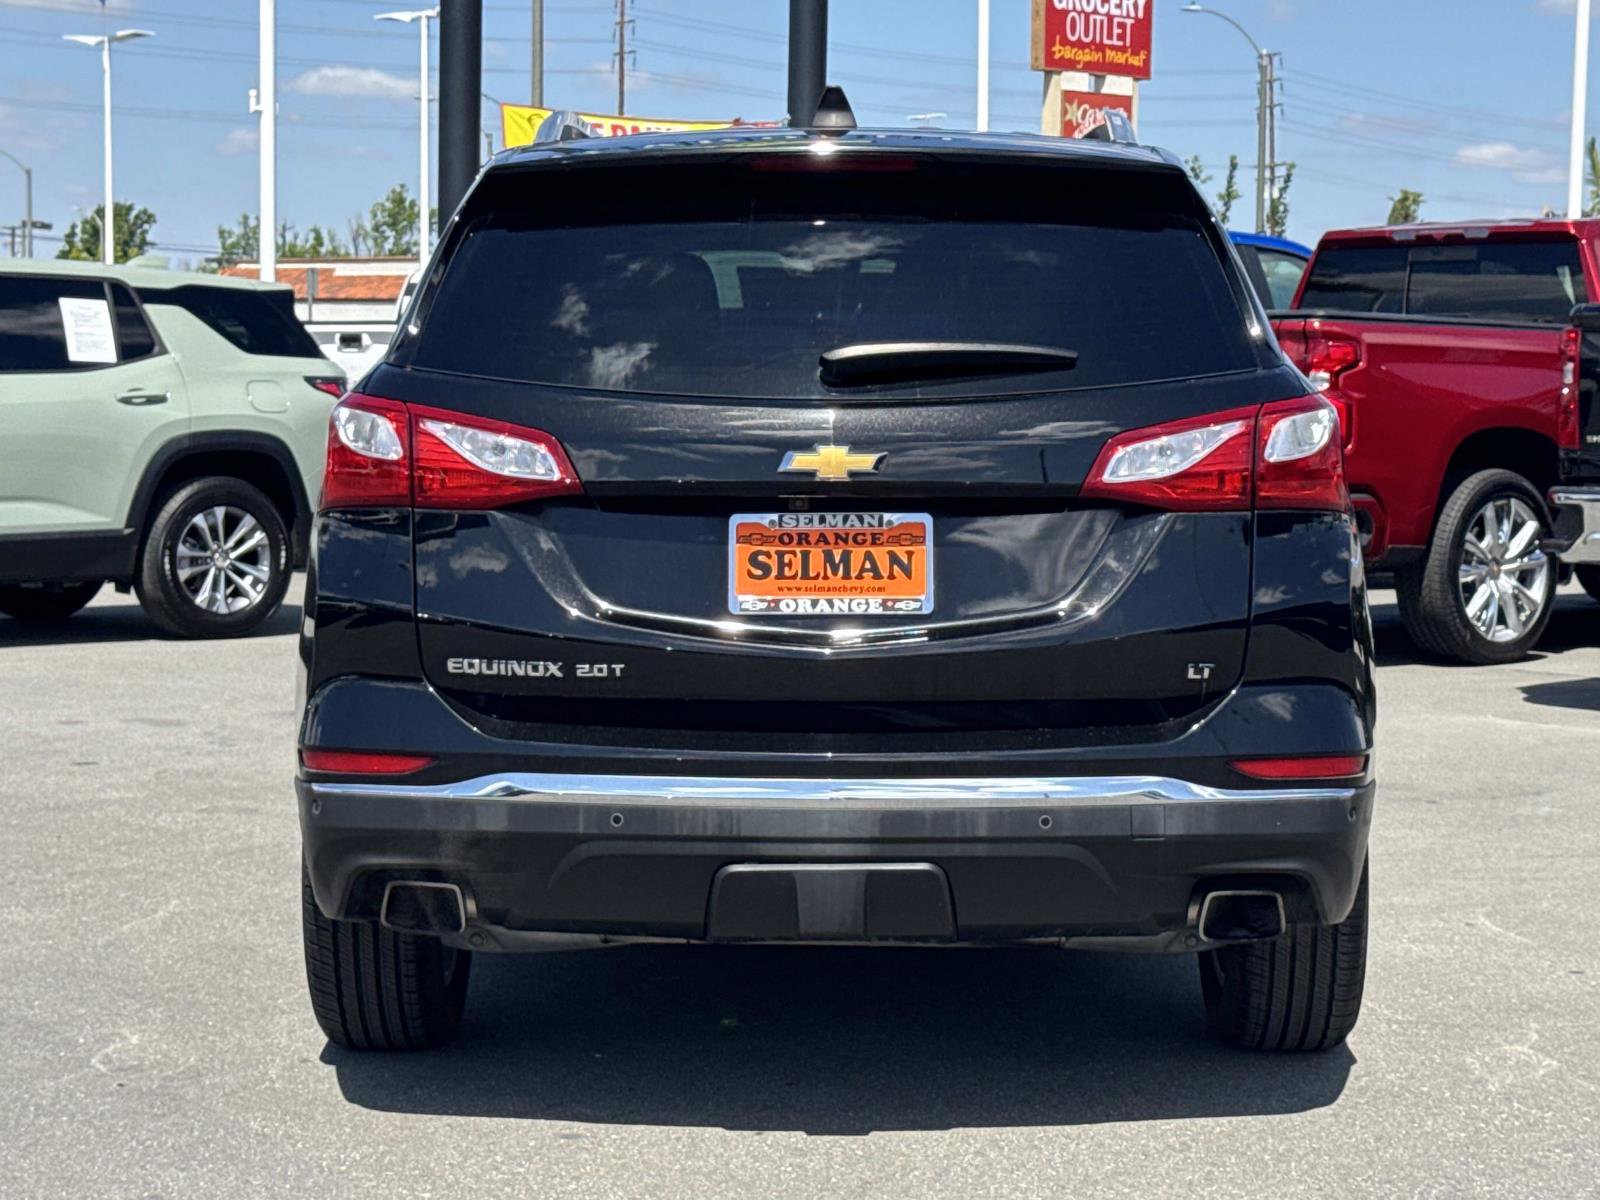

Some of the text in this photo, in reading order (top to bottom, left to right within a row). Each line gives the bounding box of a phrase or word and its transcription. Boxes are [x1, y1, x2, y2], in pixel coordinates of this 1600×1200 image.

[1066, 11, 1135, 47] OUTLET
[1051, 34, 1148, 69] bargain market
[782, 514, 880, 528] SELMAN
[778, 532, 885, 546] ORANGE
[747, 550, 914, 581] SELMAN
[777, 584, 886, 594] www.selmanchevy.com
[779, 599, 883, 613] ORANGE
[447, 657, 564, 678] EQUINOX
[1187, 663, 1215, 679] LT
